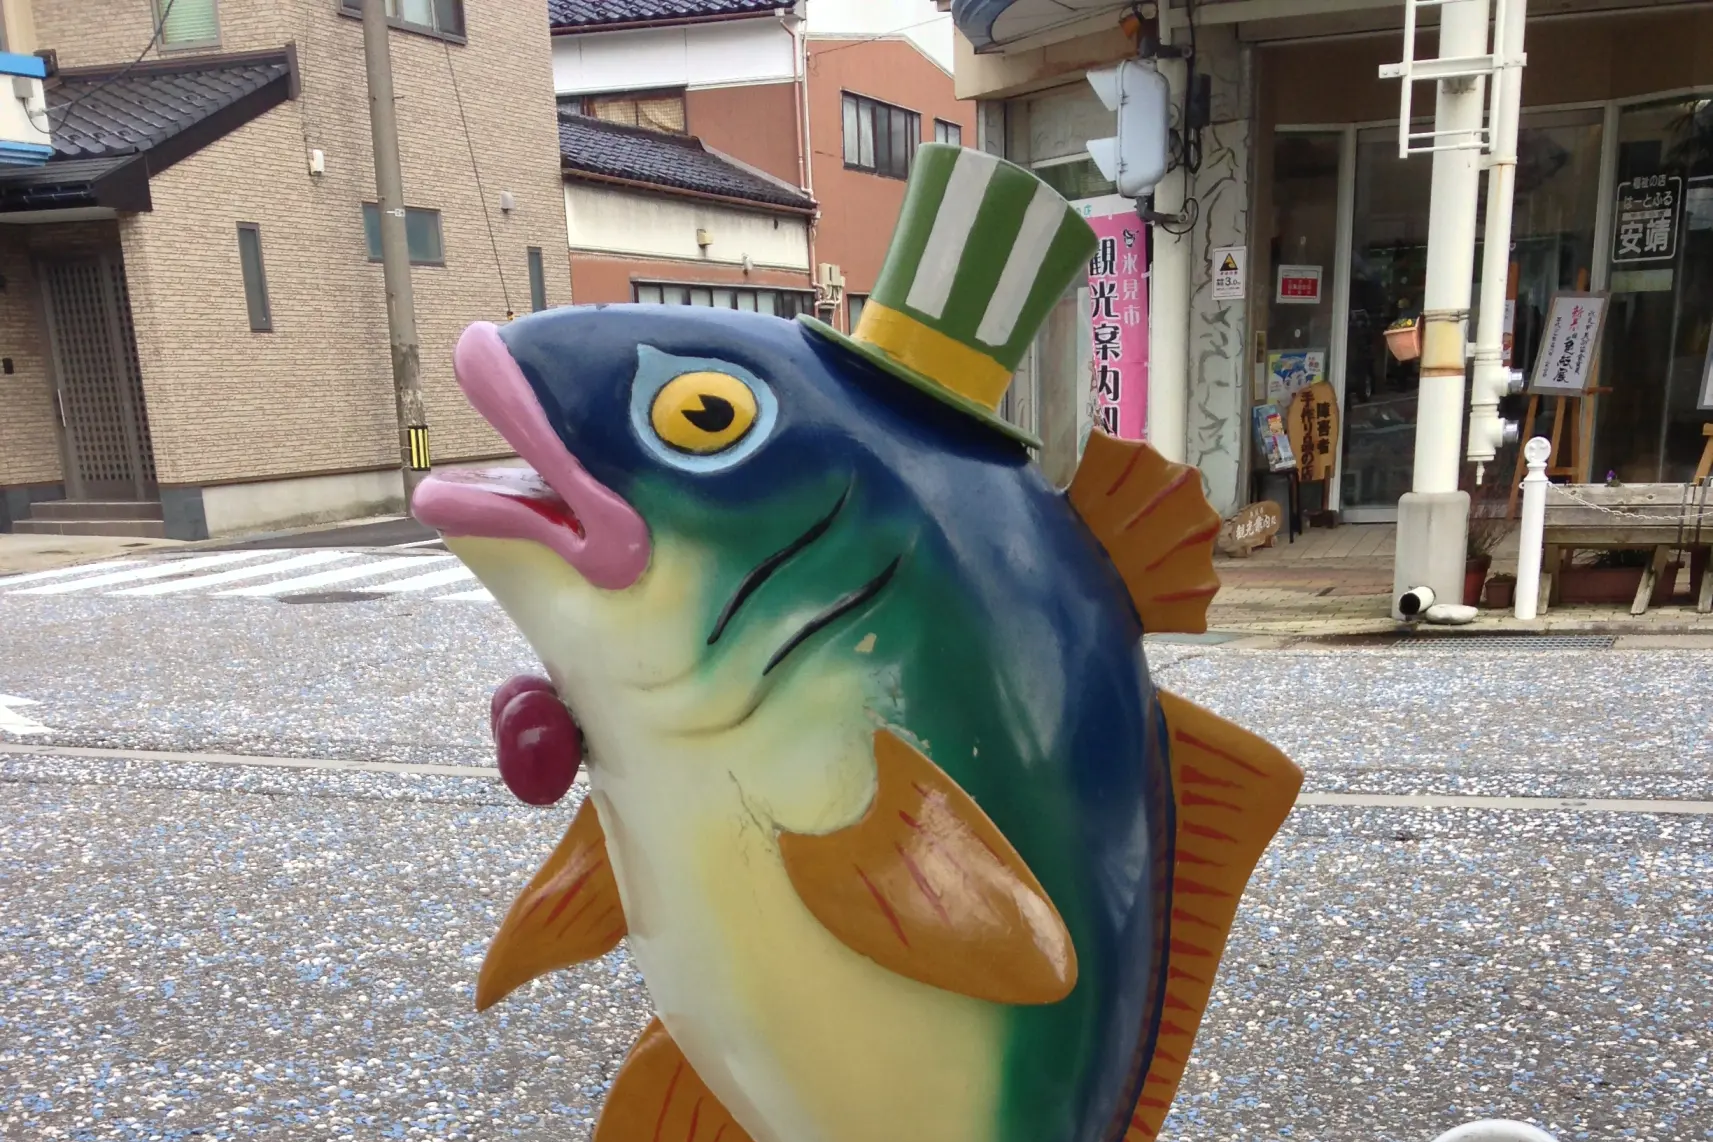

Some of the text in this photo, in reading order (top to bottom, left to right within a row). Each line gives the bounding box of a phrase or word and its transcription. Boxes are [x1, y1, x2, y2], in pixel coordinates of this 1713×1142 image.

[1624, 190, 1673, 210] はーとふる
[1618, 217, 1671, 255] 安靖
[1122, 252, 1140, 327] 氷見市
[1300, 391, 1315, 480] 手作り品の店
[1317, 402, 1331, 455] 障害者
